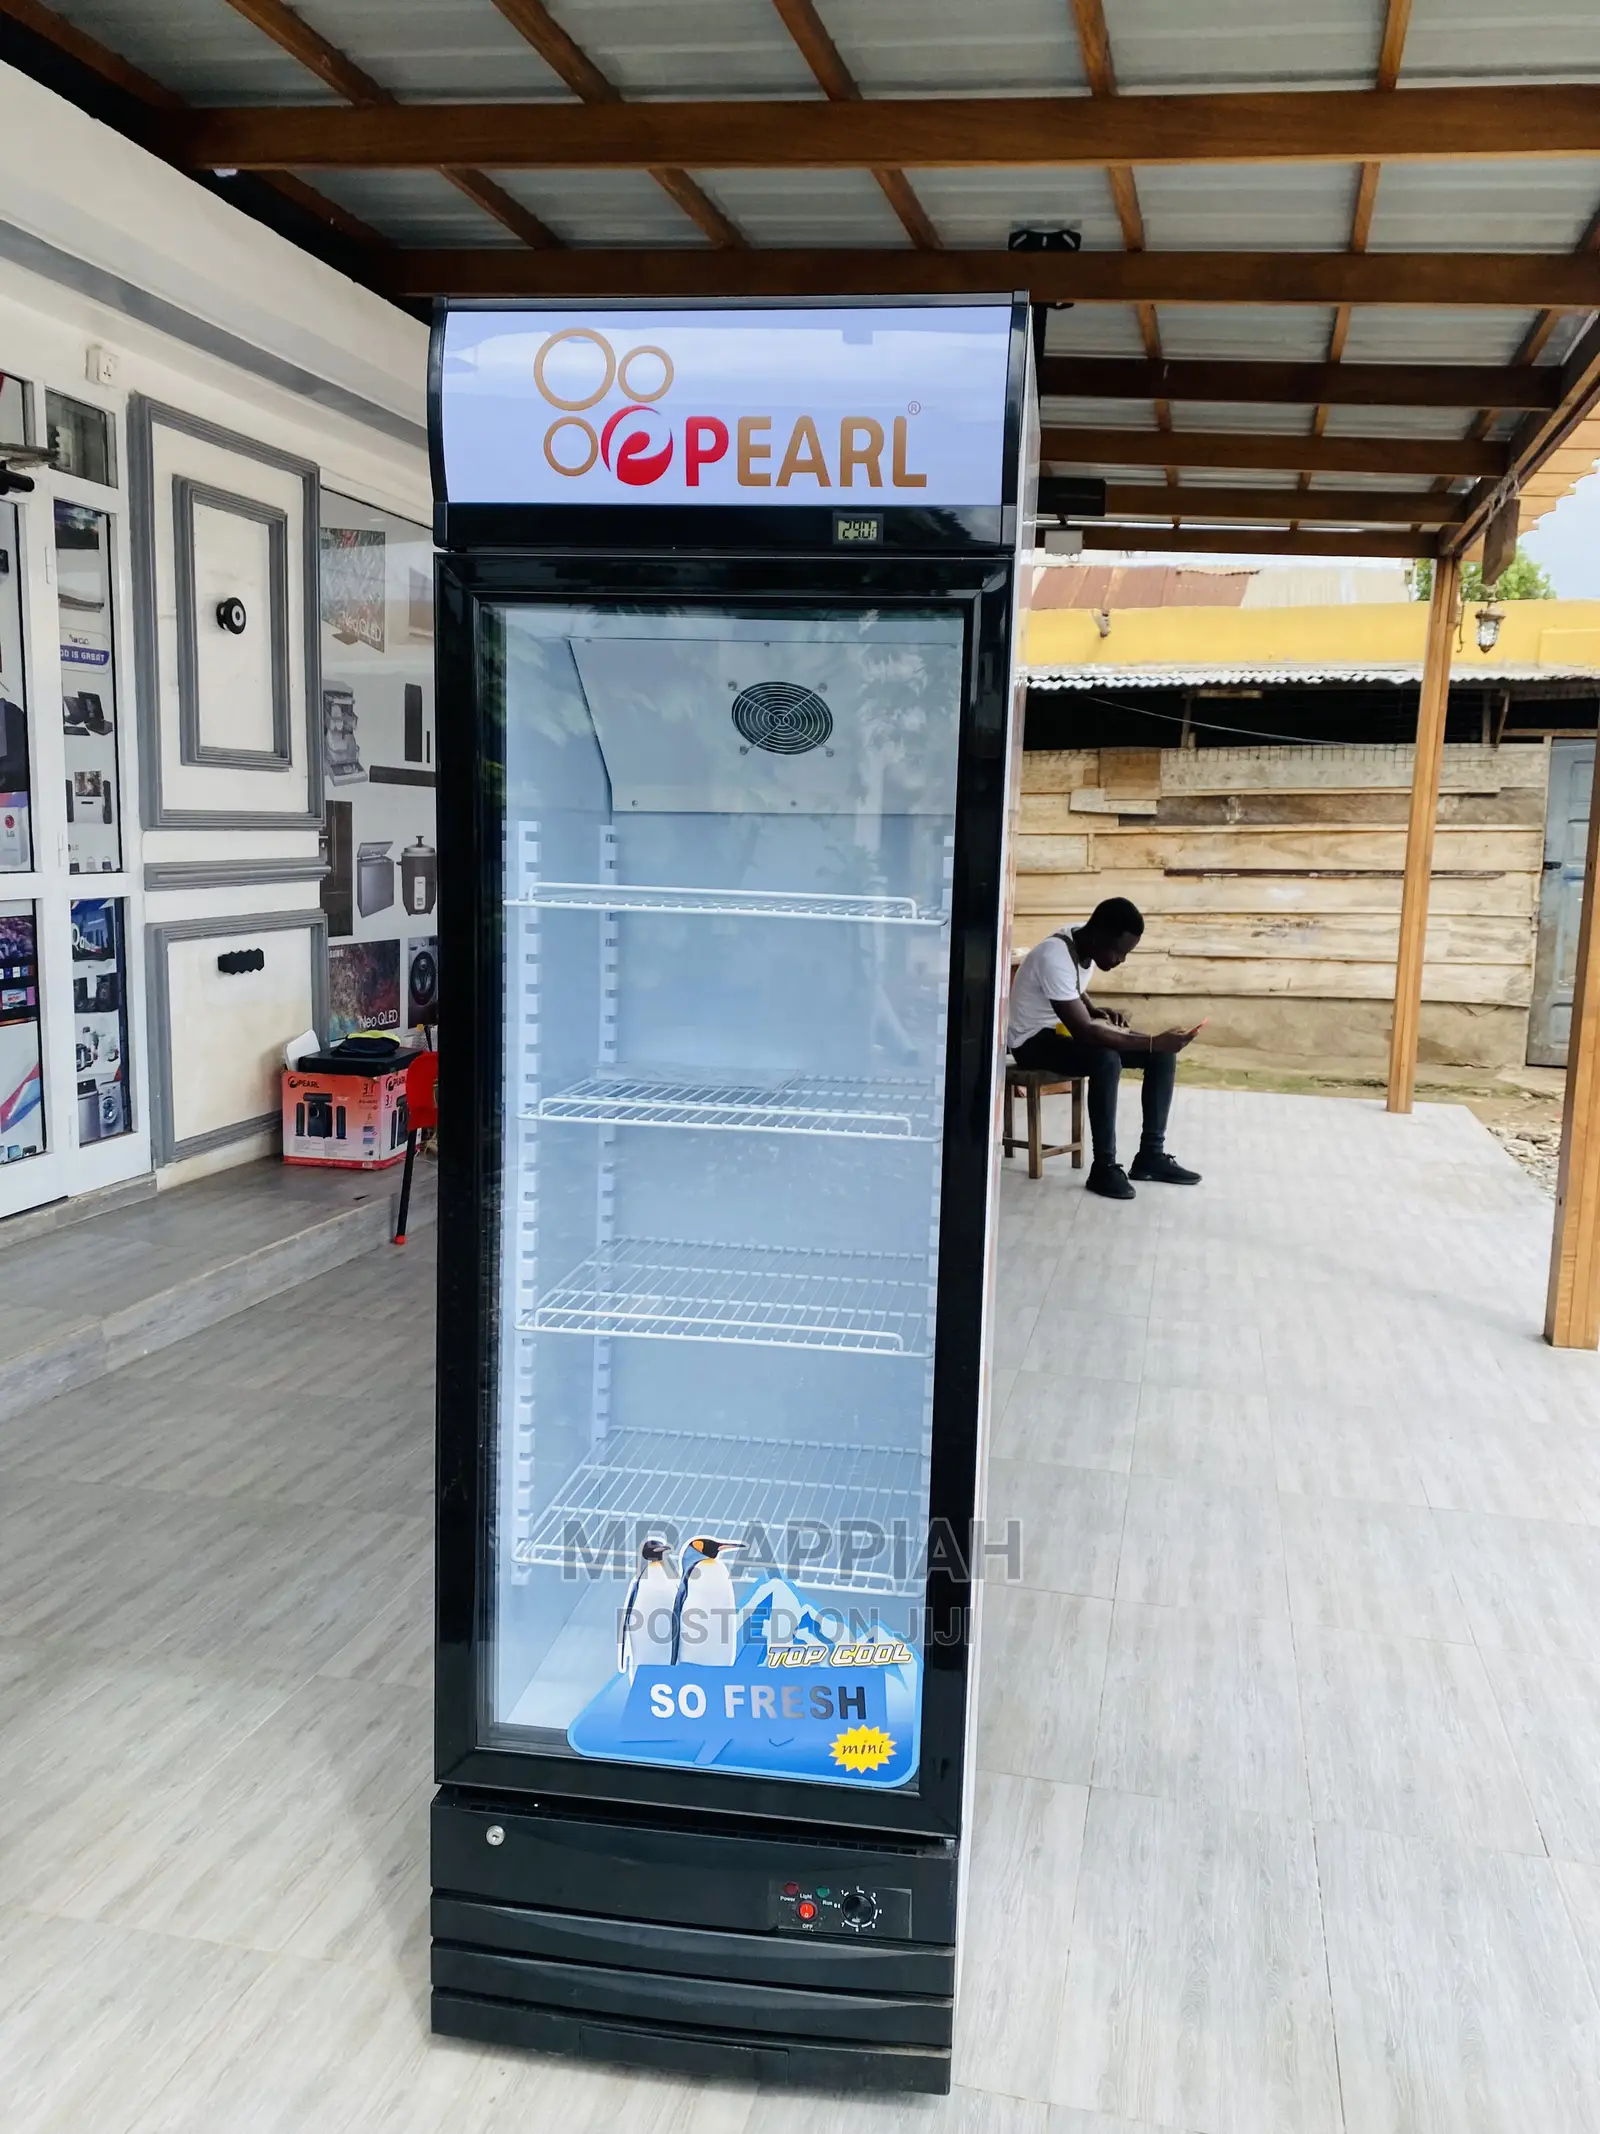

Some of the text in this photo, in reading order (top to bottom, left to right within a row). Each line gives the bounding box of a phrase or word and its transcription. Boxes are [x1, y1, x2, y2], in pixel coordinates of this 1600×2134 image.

[684, 414, 928, 488] PEARL
[72, 650, 79, 659] IS
[81, 651, 105, 663] GREAT
[360, 1009, 399, 1029] Neo QLED
[767, 1642, 913, 1669] TOP COOL
[649, 1683, 868, 1721] SO FRESH
[841, 1738, 887, 1757] mini
